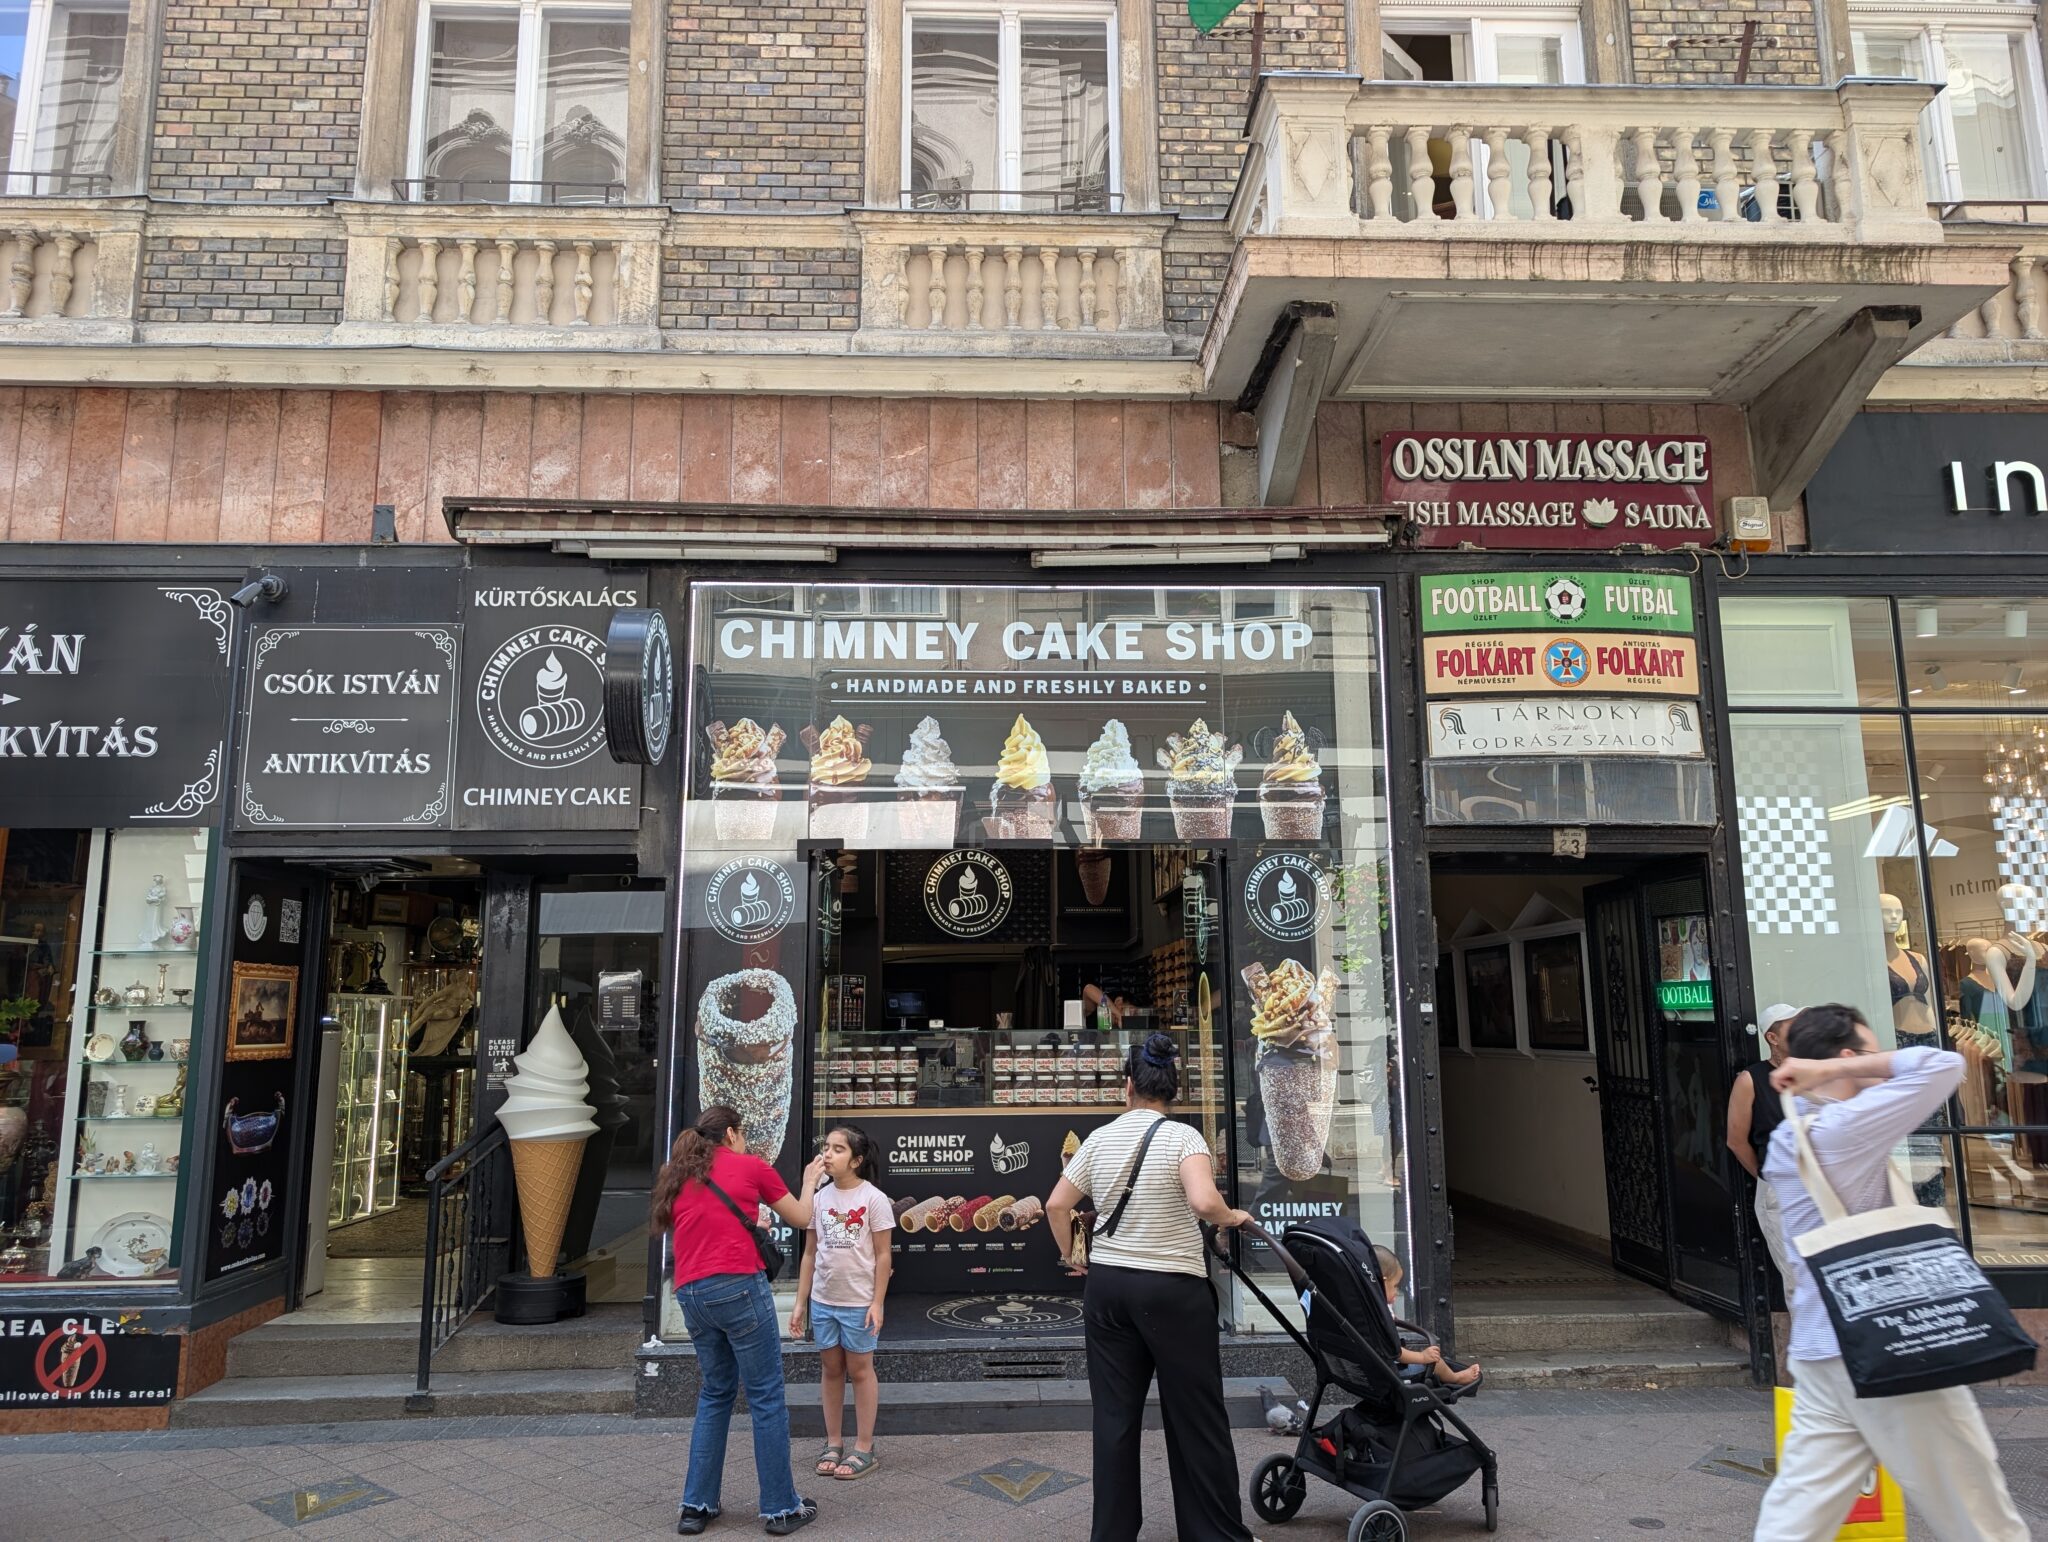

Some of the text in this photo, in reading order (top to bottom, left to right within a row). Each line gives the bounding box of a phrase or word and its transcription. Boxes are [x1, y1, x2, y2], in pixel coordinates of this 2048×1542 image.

[1392, 437, 1710, 483] OSSIAN MASSAGE
[1457, 501, 1577, 527] MASSAGE
[1624, 502, 1712, 529] SAUNA
[474, 586, 638, 607] KÜRTŐSKALÁCS
[1431, 585, 1542, 615] FOOTBALL
[1604, 585, 1679, 615] FUTBAL
[719, 619, 1313, 661] CHIMNEY CAKE SHOP
[1465, 640, 1504, 648] RÉGISÉG
[481, 630, 541, 700] CHIMNEY
[549, 629, 598, 654] CAKE
[1436, 646, 1536, 678] FOLKART
[1596, 646, 1685, 678] FOLKART
[264, 669, 441, 695] CSÓK ISTVÁN
[846, 678, 1192, 695] HANDMADE AND FRESHLY BAKED
[1490, 704, 1642, 722] TÁRNOKY
[487, 714, 524, 756] HANDMADE
[526, 752, 547, 761] AND
[550, 742, 591, 761] FRESHLY
[1458, 733, 1675, 750] FODRÁSZ SZALON
[262, 748, 432, 774] ANTIKVITÁS
[708, 858, 793, 903] CHIMNEY CAKE SHOP
[926, 851, 1010, 899] CHIMNEY CAKE SHOP
[1247, 856, 1329, 900] CHIMNEY CAKE SHOP
[952, 925, 965, 933] AND
[1656, 985, 1713, 1004] FOOTBALL
[896, 1134, 967, 1148] CHIMNEY
[888, 1149, 974, 1163] CAKE SHOP
[1260, 1202, 1343, 1217] CHIMNEY
[67, 1390, 82, 1400] in
[90, 1389, 121, 1399] this
[129, 1388, 171, 1399] area!
